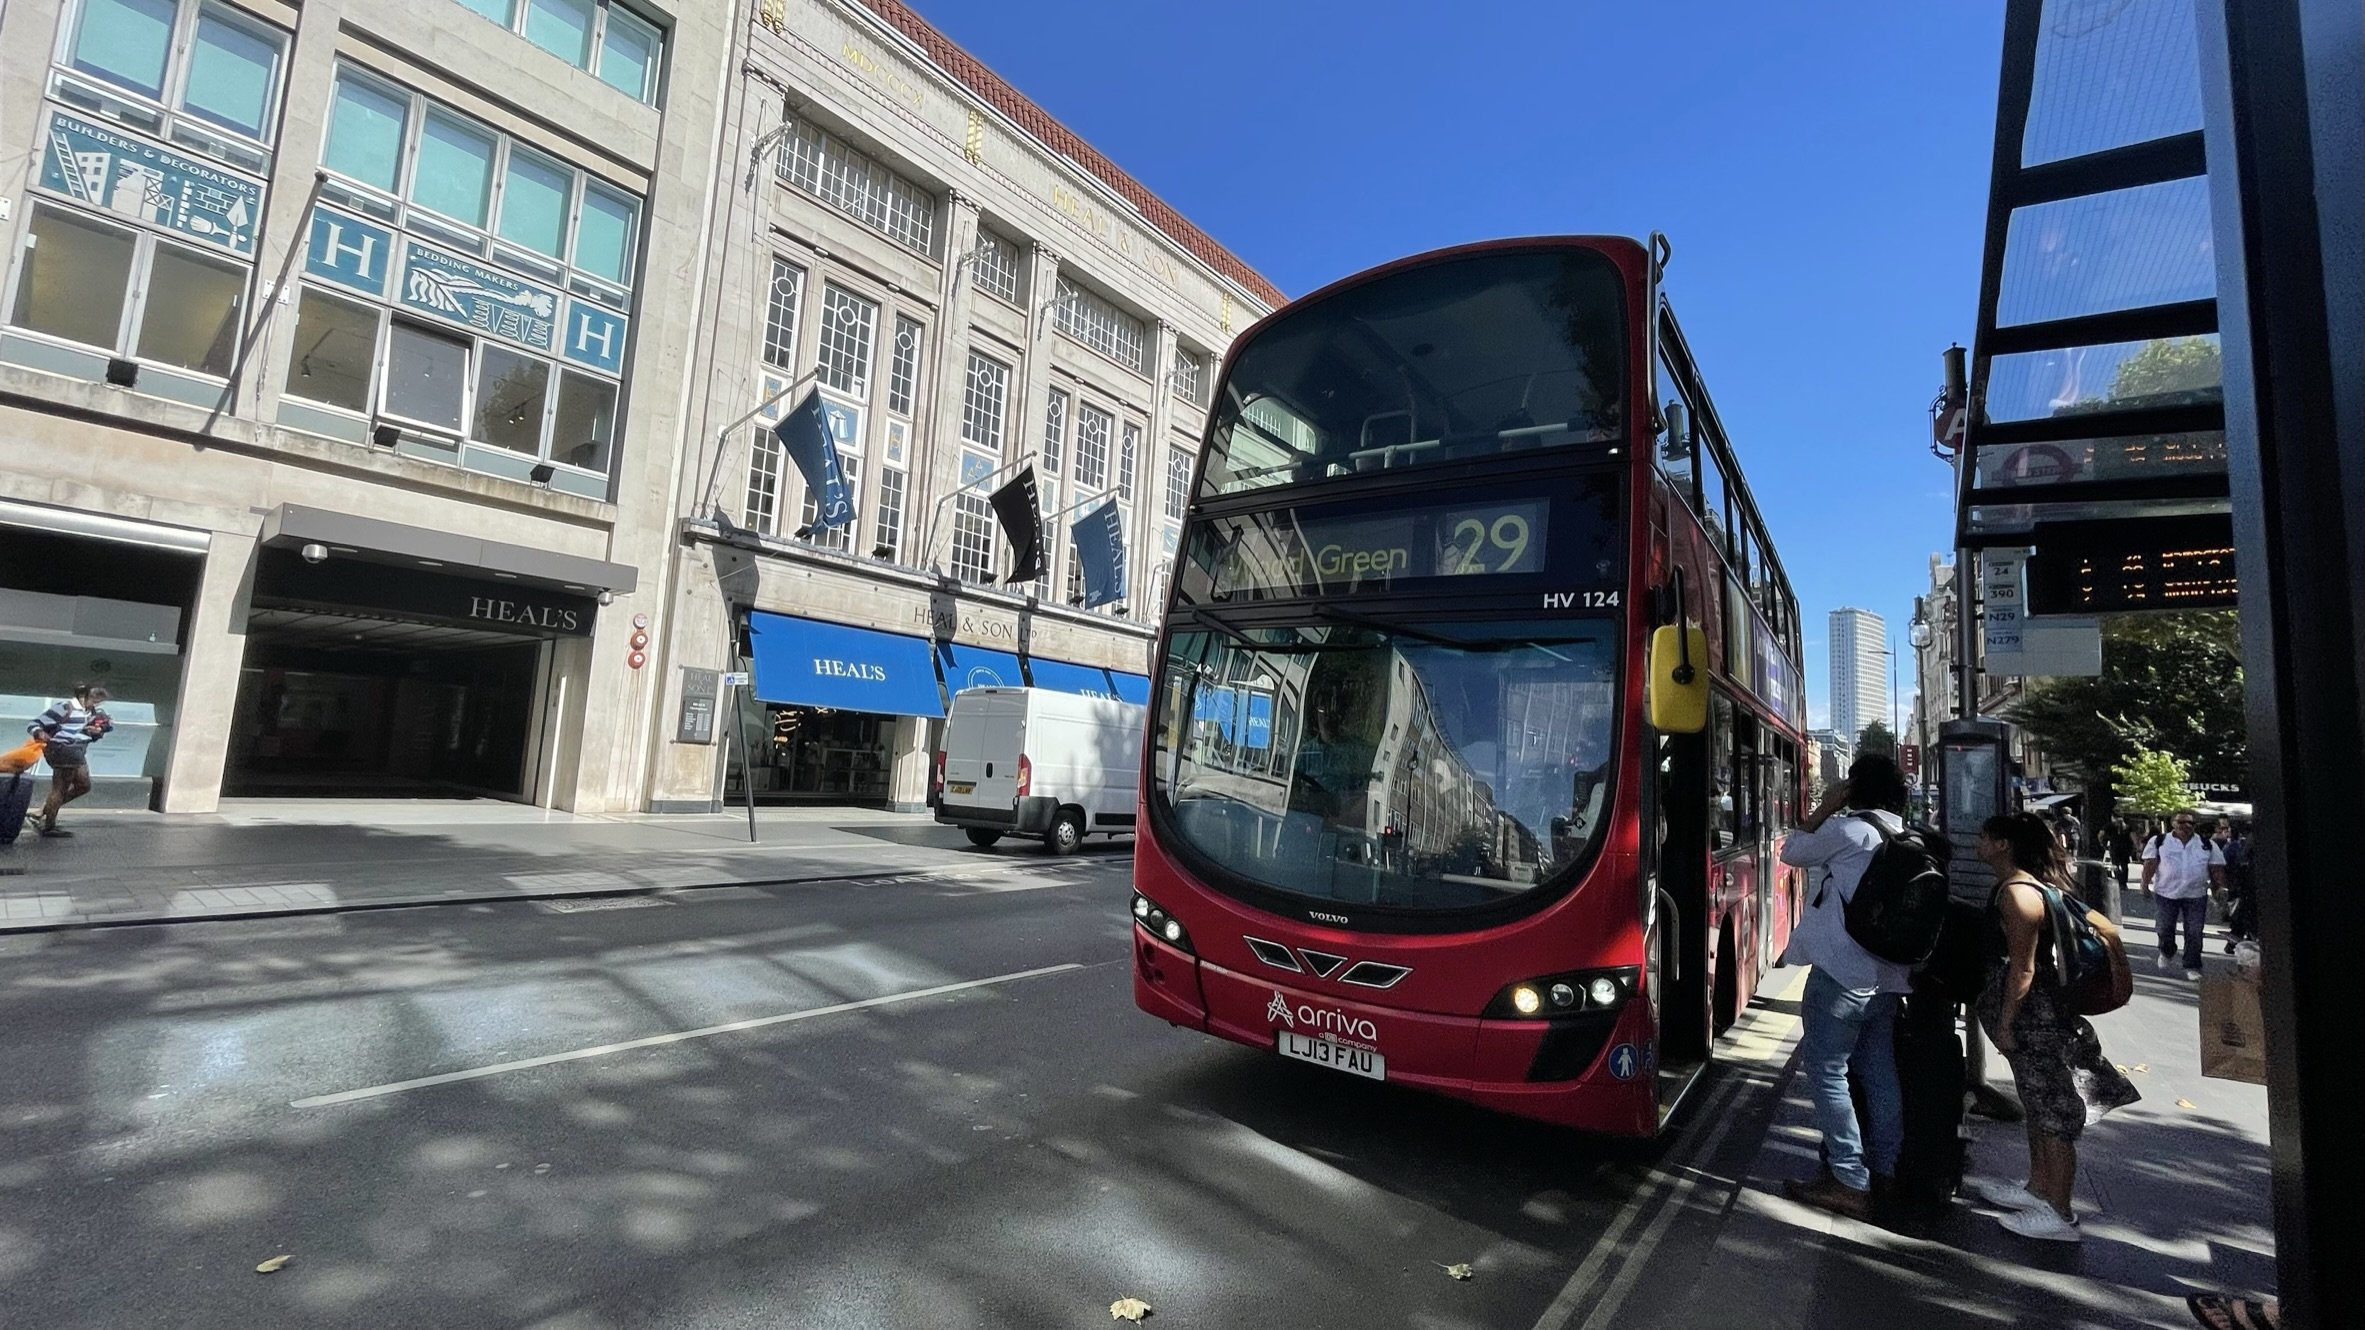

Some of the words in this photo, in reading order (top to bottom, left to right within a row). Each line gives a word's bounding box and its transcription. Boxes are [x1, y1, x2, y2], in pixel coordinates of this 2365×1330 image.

[56, 117, 138, 153] BUILDERS
[144, 149, 155, 159] &
[160, 153, 256, 196] DECORATORS
[322, 222, 377, 279] H
[1053, 184, 1107, 237] HEAL
[1142, 249, 1178, 286] SON
[416, 248, 470, 273] BEDDING
[474, 269, 519, 292] MAKERS
[576, 313, 615, 360] H
[1317, 545, 1407, 575] Green
[1454, 514, 1530, 575] 29
[1994, 567, 2009, 576] 24
[1544, 593, 1575, 608] HV
[1583, 591, 1619, 607] 124
[1990, 589, 2014, 598] 390
[469, 596, 577, 630] HEAL'S
[914, 607, 954, 629] HEAL
[962, 617, 974, 633] &
[982, 620, 1013, 641] SON
[1989, 613, 2015, 621] N29
[813, 659, 886, 681] HEAL'S
[1309, 911, 1349, 924] VOLVO
[1298, 1005, 1377, 1041] arriva
[1290, 1034, 1330, 1062] LJ13
[1335, 1047, 1372, 1073] FAU
[1338, 1037, 1378, 1053] company
